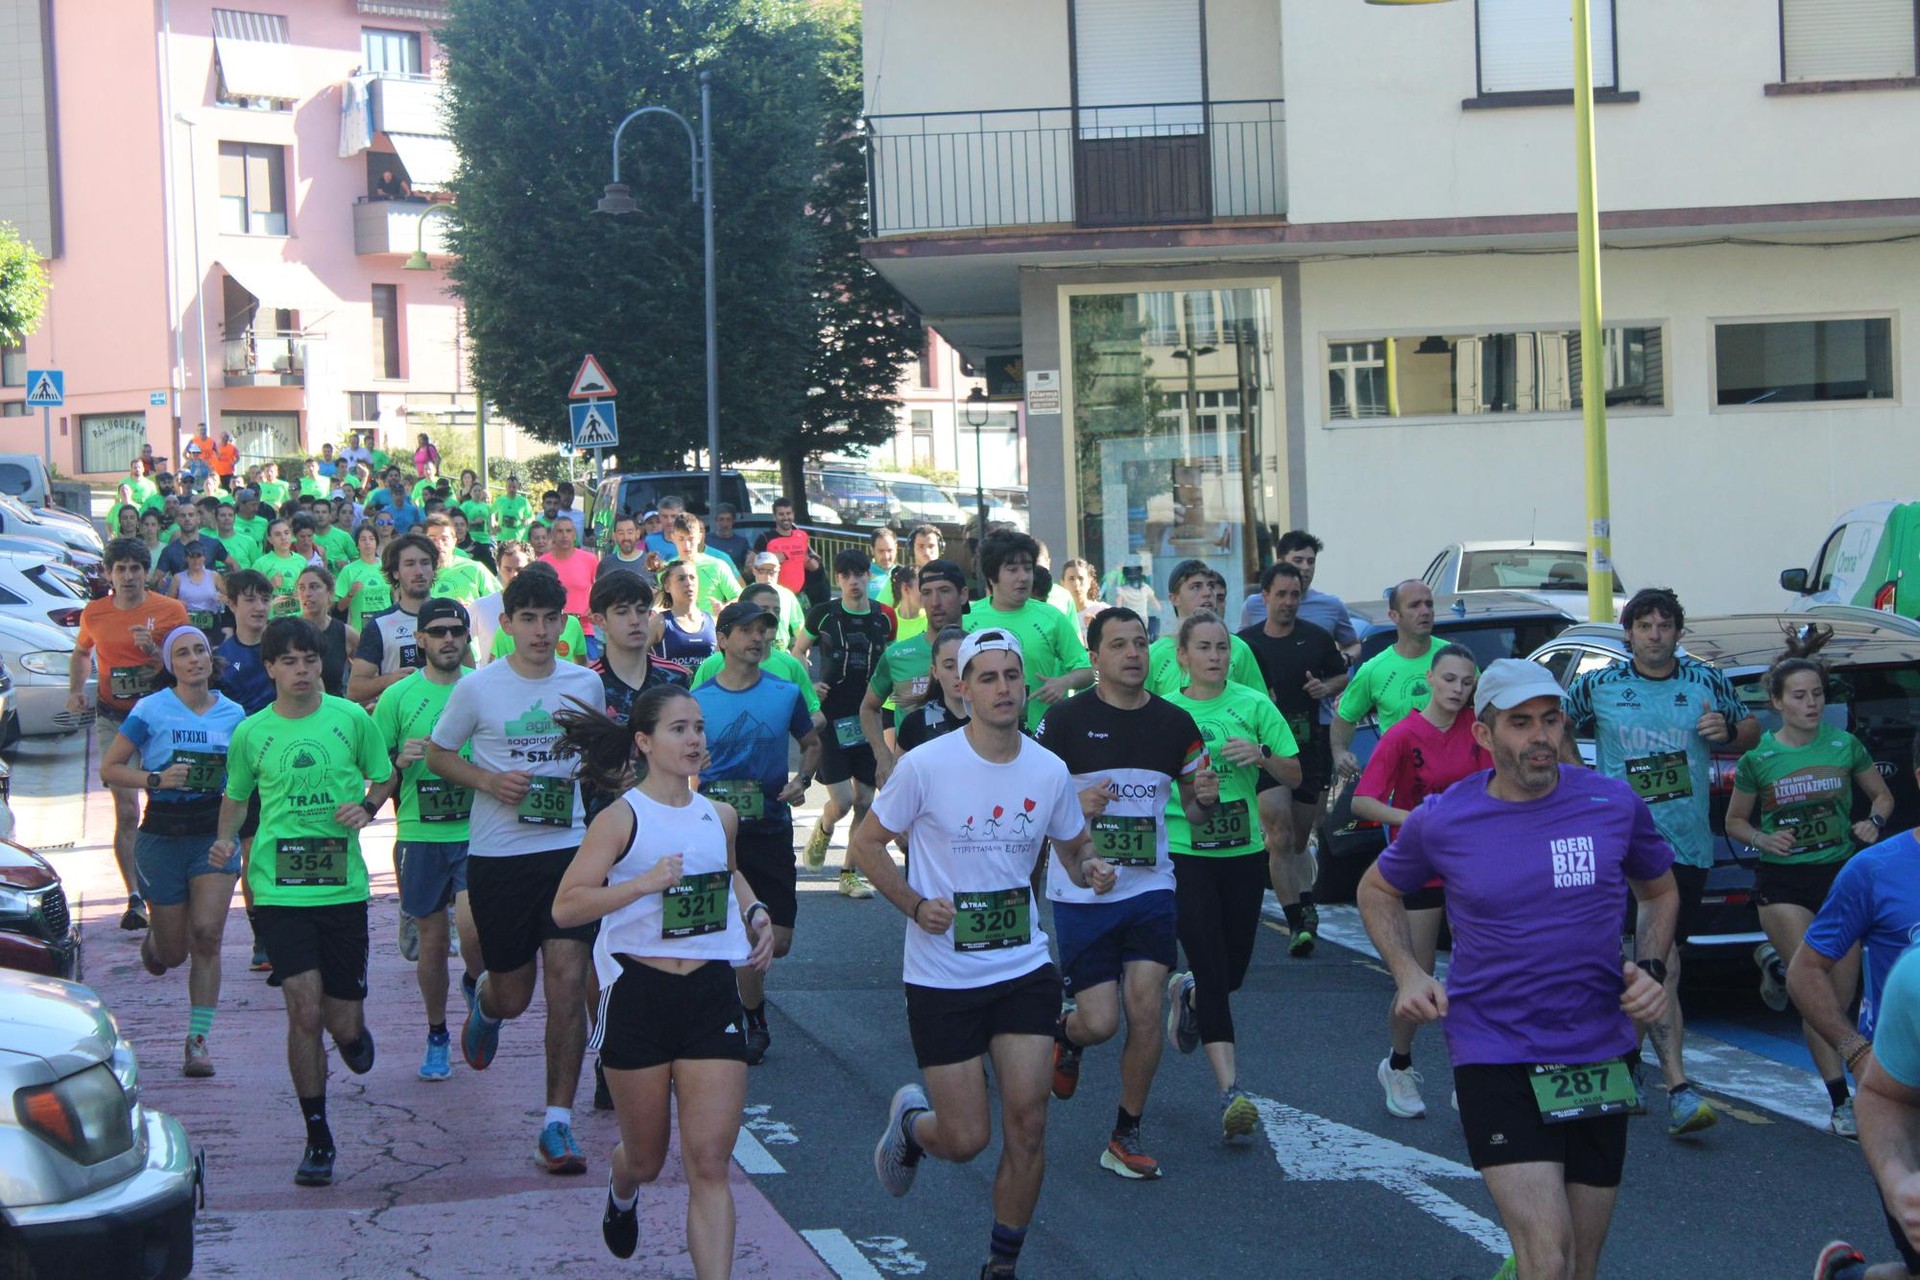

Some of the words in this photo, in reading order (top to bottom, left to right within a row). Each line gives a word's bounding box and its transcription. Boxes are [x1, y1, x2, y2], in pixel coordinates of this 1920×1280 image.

[172, 730, 207, 744] INTXIXU
[1413, 748, 1424, 768] 3
[1210, 764, 1233, 774] AIL
[1875, 764, 1893, 775] IA
[1638, 769, 1678, 790] 379
[1774, 777, 1842, 799] AZKOITIAZPEITIA
[288, 792, 335, 807] TRAIL
[429, 791, 467, 809] 147
[530, 793, 565, 811] 356
[1203, 817, 1240, 835] 330
[1103, 833, 1143, 850] 331
[1550, 836, 1594, 854] IGERI
[290, 854, 334, 871] 354
[1552, 851, 1596, 874] BIZI
[1554, 871, 1596, 889] KORRI
[677, 893, 715, 918] 321
[970, 909, 1017, 933] 320
[1551, 1068, 1610, 1098] 287
